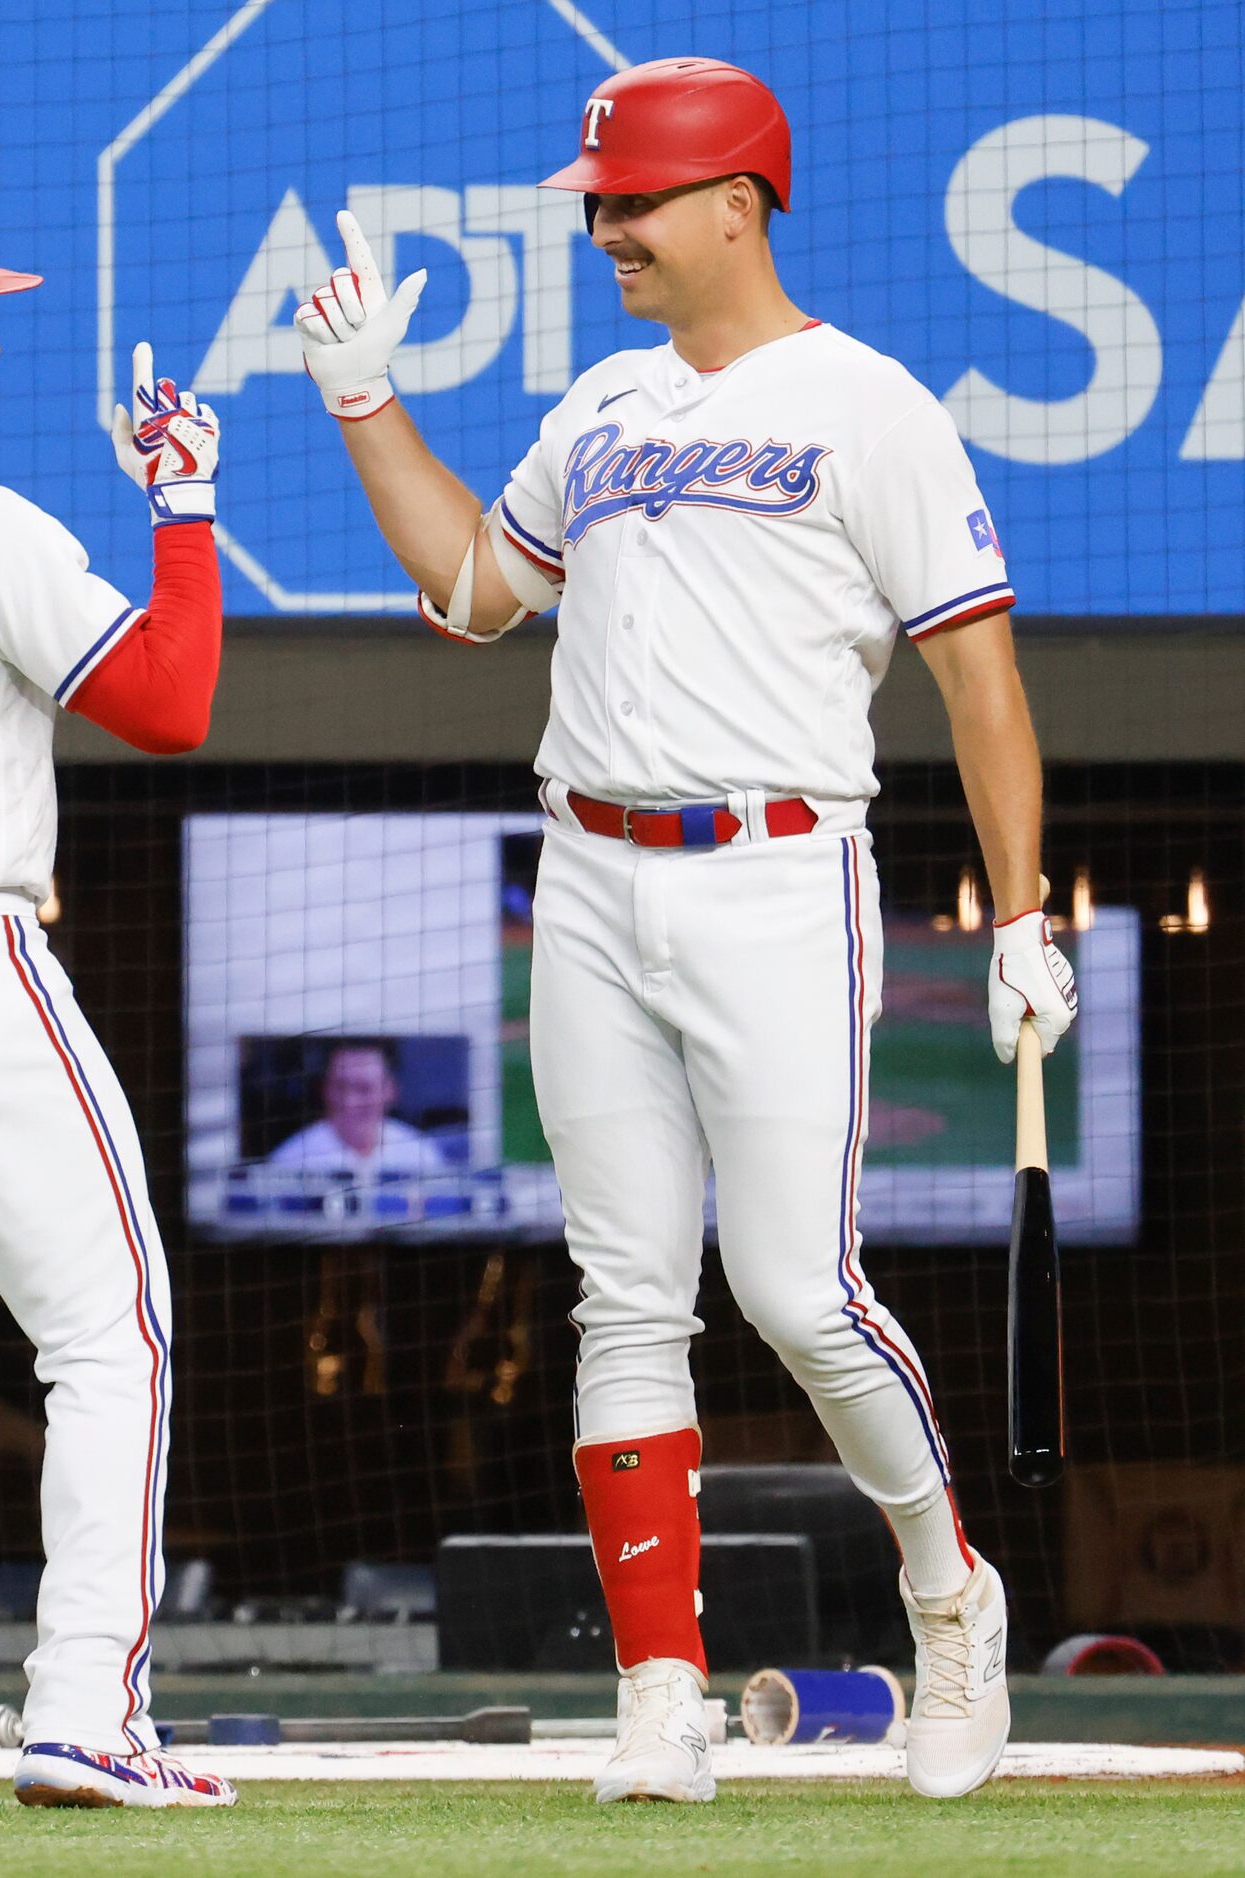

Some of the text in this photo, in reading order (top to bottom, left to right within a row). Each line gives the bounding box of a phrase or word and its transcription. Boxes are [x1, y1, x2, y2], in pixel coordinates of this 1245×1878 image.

[584, 98, 615, 151] T
[190, 183, 588, 395] ADT
[563, 420, 834, 545] Rangers
[618, 1535, 660, 1563] Lowe
